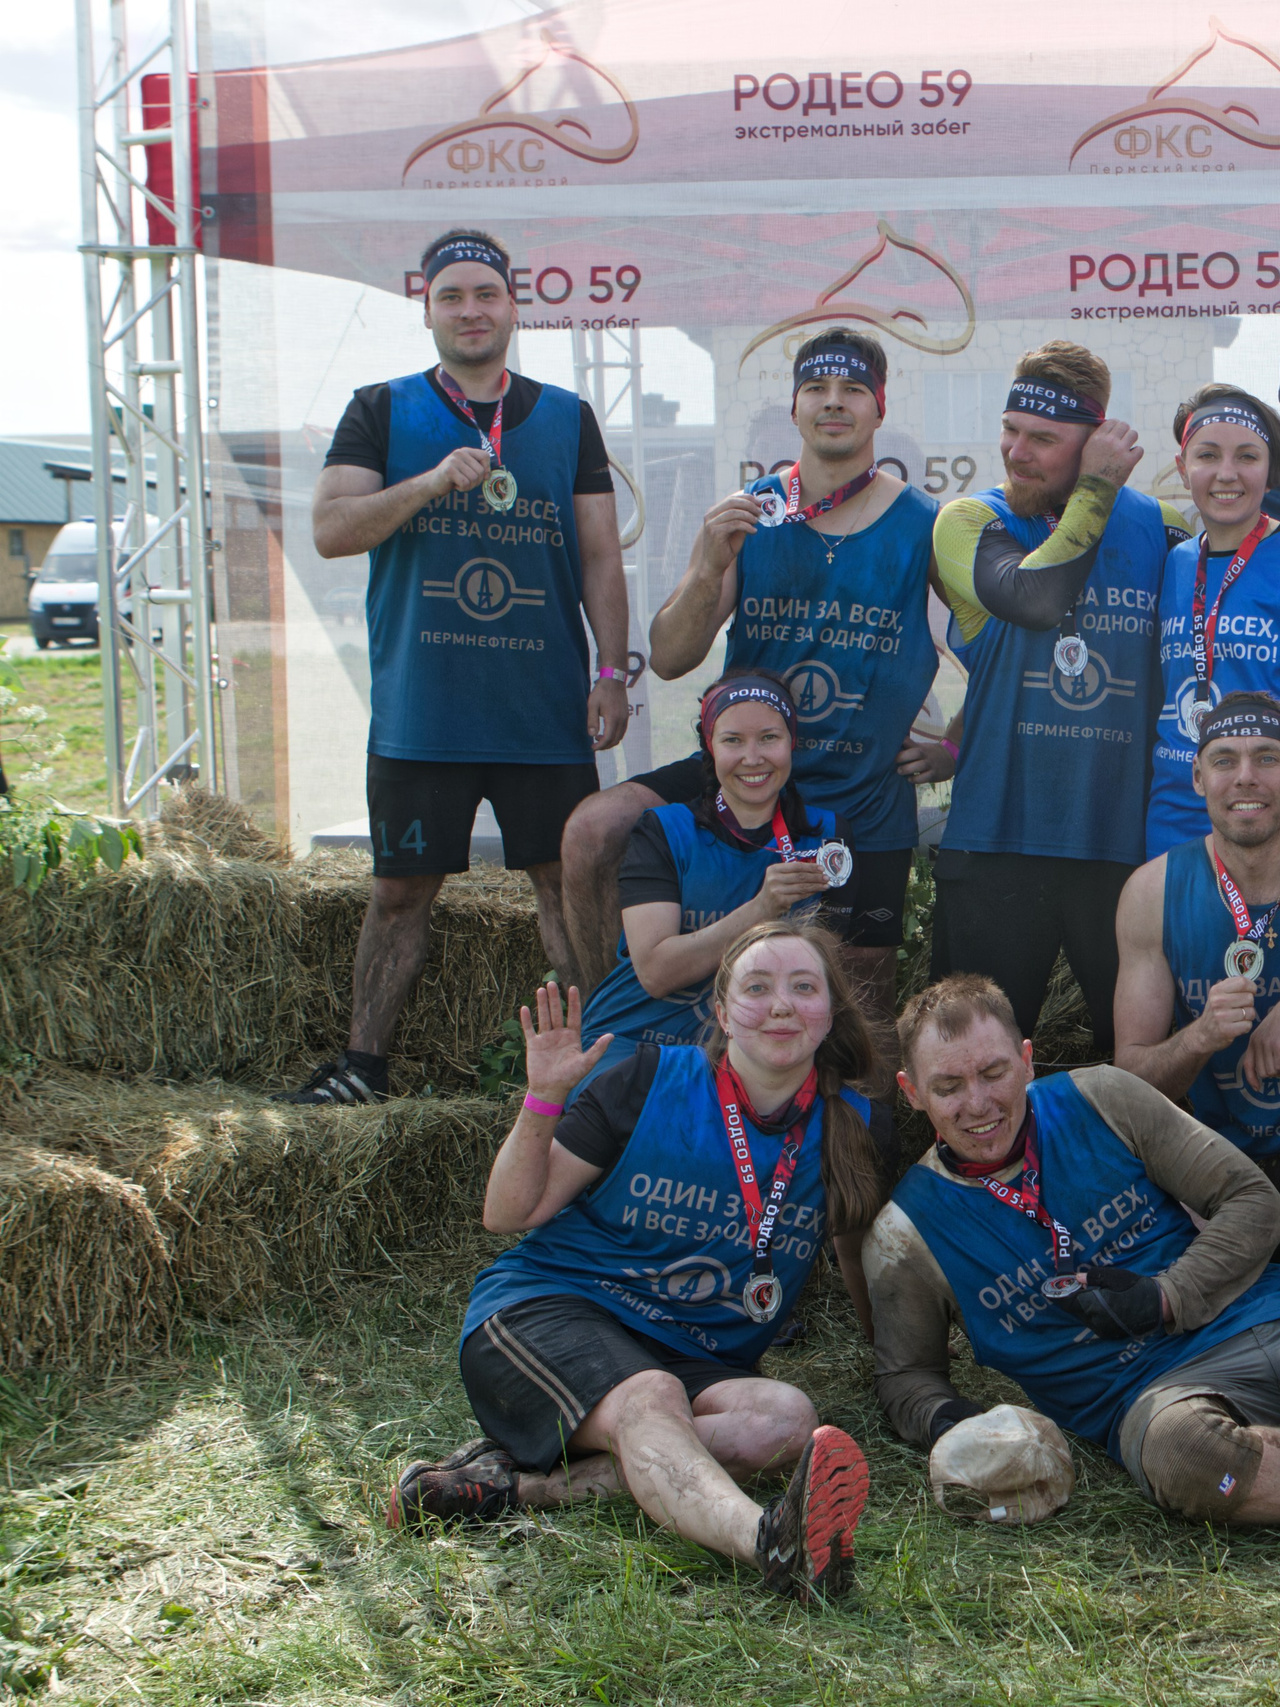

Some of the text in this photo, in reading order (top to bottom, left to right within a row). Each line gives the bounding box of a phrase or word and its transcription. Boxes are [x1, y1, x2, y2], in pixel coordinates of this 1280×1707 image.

[733, 69, 973, 116] РОДЕО 59
[734, 118, 971, 142] экстремальный забег
[1114, 124, 1213, 160] ФКС
[446, 139, 545, 176] ФКС
[1090, 162, 1236, 176] Пермский край
[423, 176, 569, 191] Пермский край
[437, 241, 486, 257] РОДЕО
[454, 250, 491, 263] 3175
[404, 264, 642, 305] РЕО 59
[1069, 252, 1240, 298] РОДЕО
[1070, 300, 1241, 322] экстремальный
[800, 353, 867, 373] РОДЕО 59
[812, 366, 849, 378] 3158
[1012, 382, 1078, 409] РОДЕО 59
[1018, 396, 1057, 416] 3174
[924, 455, 977, 495] 59
[786, 476, 800, 514] РОДЕО
[417, 517, 452, 535] ВСЕ
[457, 519, 482, 539] ЗА
[1222, 556, 1246, 595] РОДЕ
[743, 597, 904, 635] ОДИН ЗА ВСЕХ,
[1194, 613, 1204, 631] 59
[1218, 615, 1279, 643] ВСЕХ,
[420, 630, 545, 651] ПЕРМНЕФТЕГАЗ
[795, 626, 814, 643] ЗА
[819, 627, 900, 655] ОДНОГО!
[1212, 642, 1277, 664] ДНОГО!
[1193, 633, 1208, 681] РОДЕО
[729, 687, 779, 703] РОДЕО
[1017, 721, 1133, 744] ПЕРМНЕФТЕГАЗ
[1206, 714, 1280, 736] РОДЕО 59
[376, 818, 427, 857] 14
[1221, 872, 1250, 929] РОДЕО 59
[725, 1102, 755, 1184] РОДЕО 59
[629, 1172, 718, 1213] ОДИН
[782, 1202, 826, 1240] СЕХ,
[755, 1180, 786, 1258] РОДЕО 59
[621, 1205, 818, 1262] И ВСЕ ЗА ОДОГО!
[978, 1183, 1148, 1310] ОДИН ВСЕХ,
[999, 1313, 1022, 1335] И
